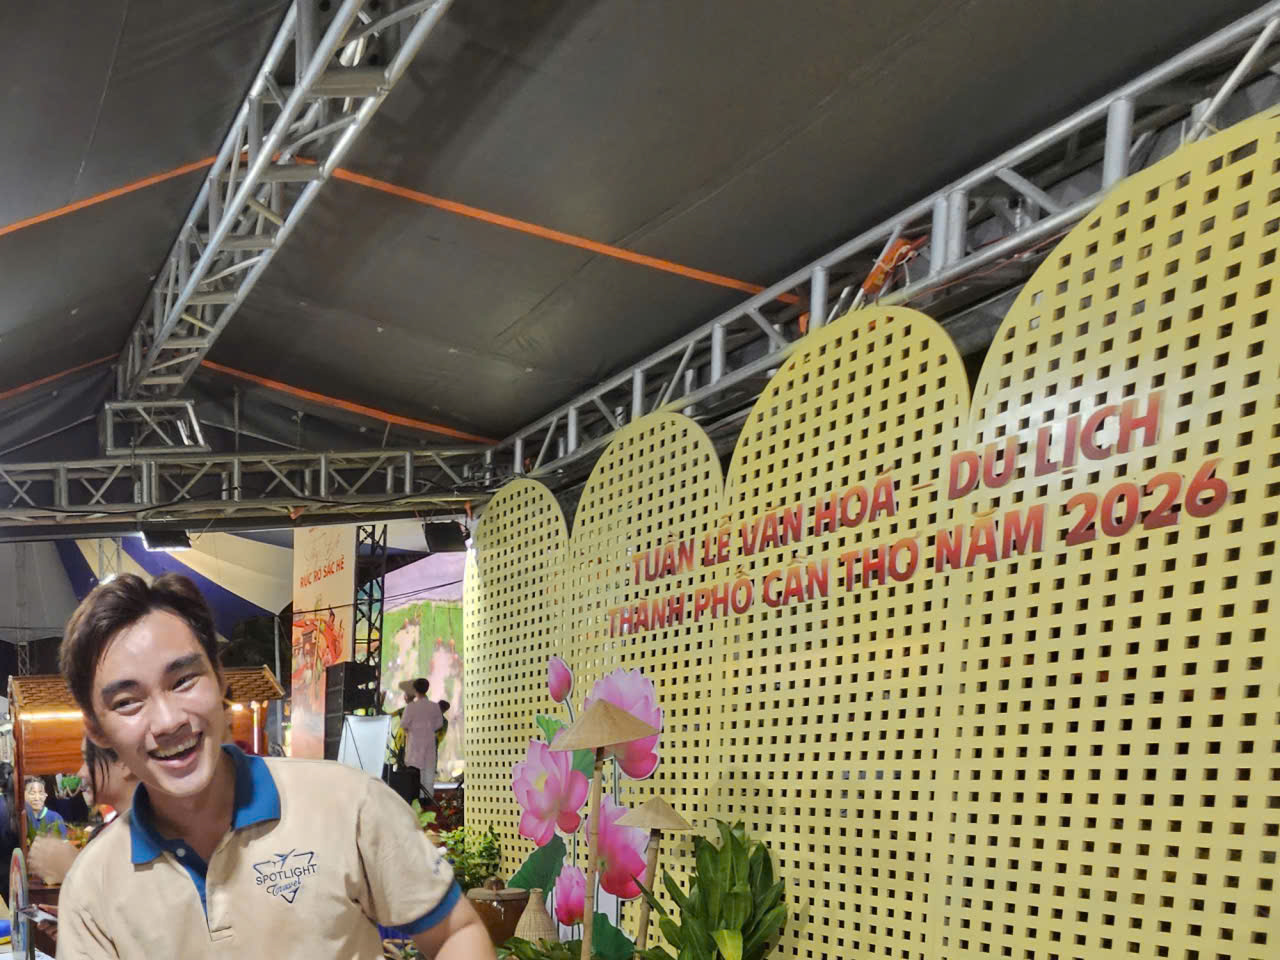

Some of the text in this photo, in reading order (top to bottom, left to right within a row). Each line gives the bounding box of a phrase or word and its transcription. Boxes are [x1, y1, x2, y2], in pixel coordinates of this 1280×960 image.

[608, 457, 1229, 638] THÀNH PHỐ CẦN THƠ NĂM 2026
[632, 532, 695, 585] TUẦN
[704, 512, 733, 567] LỄ
[741, 503, 804, 557] VĂN
[814, 465, 896, 537] HOÁ
[948, 434, 1020, 501] DU
[1034, 390, 1166, 477] LỊCH
[256, 864, 317, 886] SPOTLIGHT
